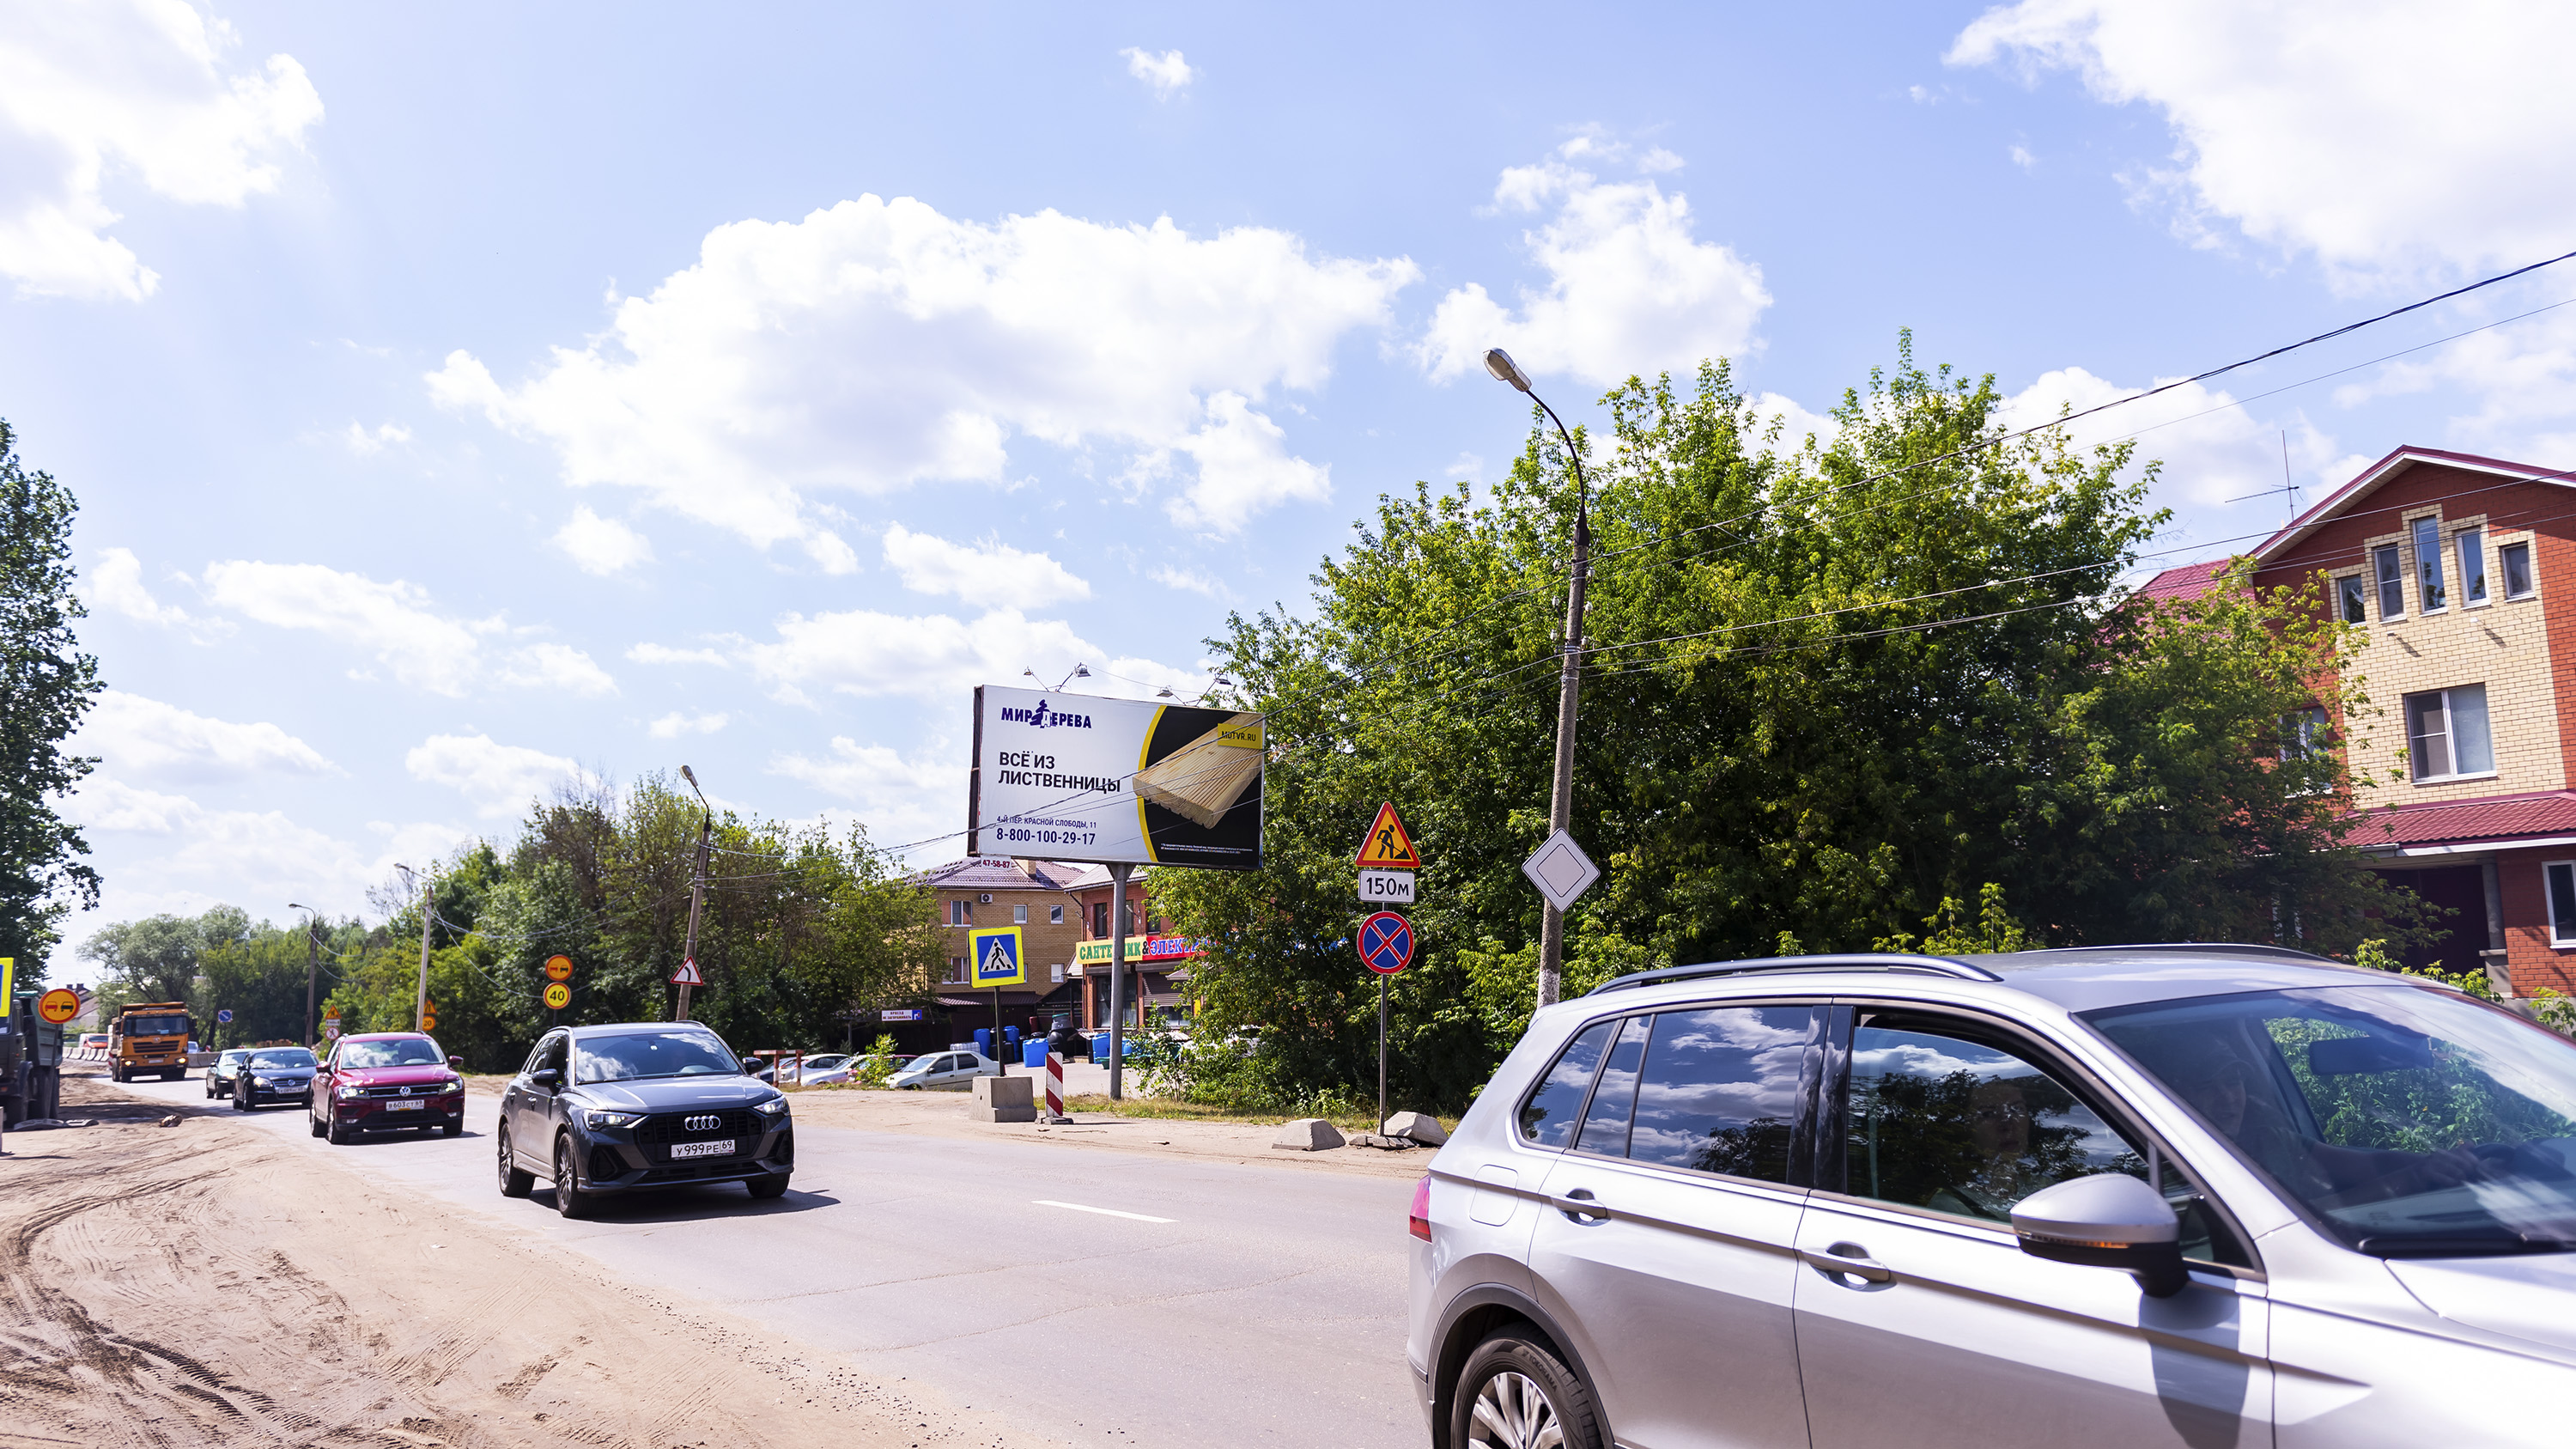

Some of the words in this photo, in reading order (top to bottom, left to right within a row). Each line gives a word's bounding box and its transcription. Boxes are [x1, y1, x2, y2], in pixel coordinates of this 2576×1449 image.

[1000, 707, 1033, 723] МИР
[1040, 709, 1092, 728] ДЕРЕВА
[999, 750, 1030, 768] ВСЁ
[1034, 754, 1055, 770] ИЗ
[998, 770, 1121, 795] ЛИСТВЕННИЦЫ
[1024, 817, 1054, 826] КРАСНОЙ
[996, 827, 1097, 846] 8-800-100-29-17
[982, 859, 1011, 868] 47-58-87
[550, 990, 565, 1002] 40
[721, 1140, 732, 1149] 69
[1528, 1354, 1558, 1392] YOKOHAMA
